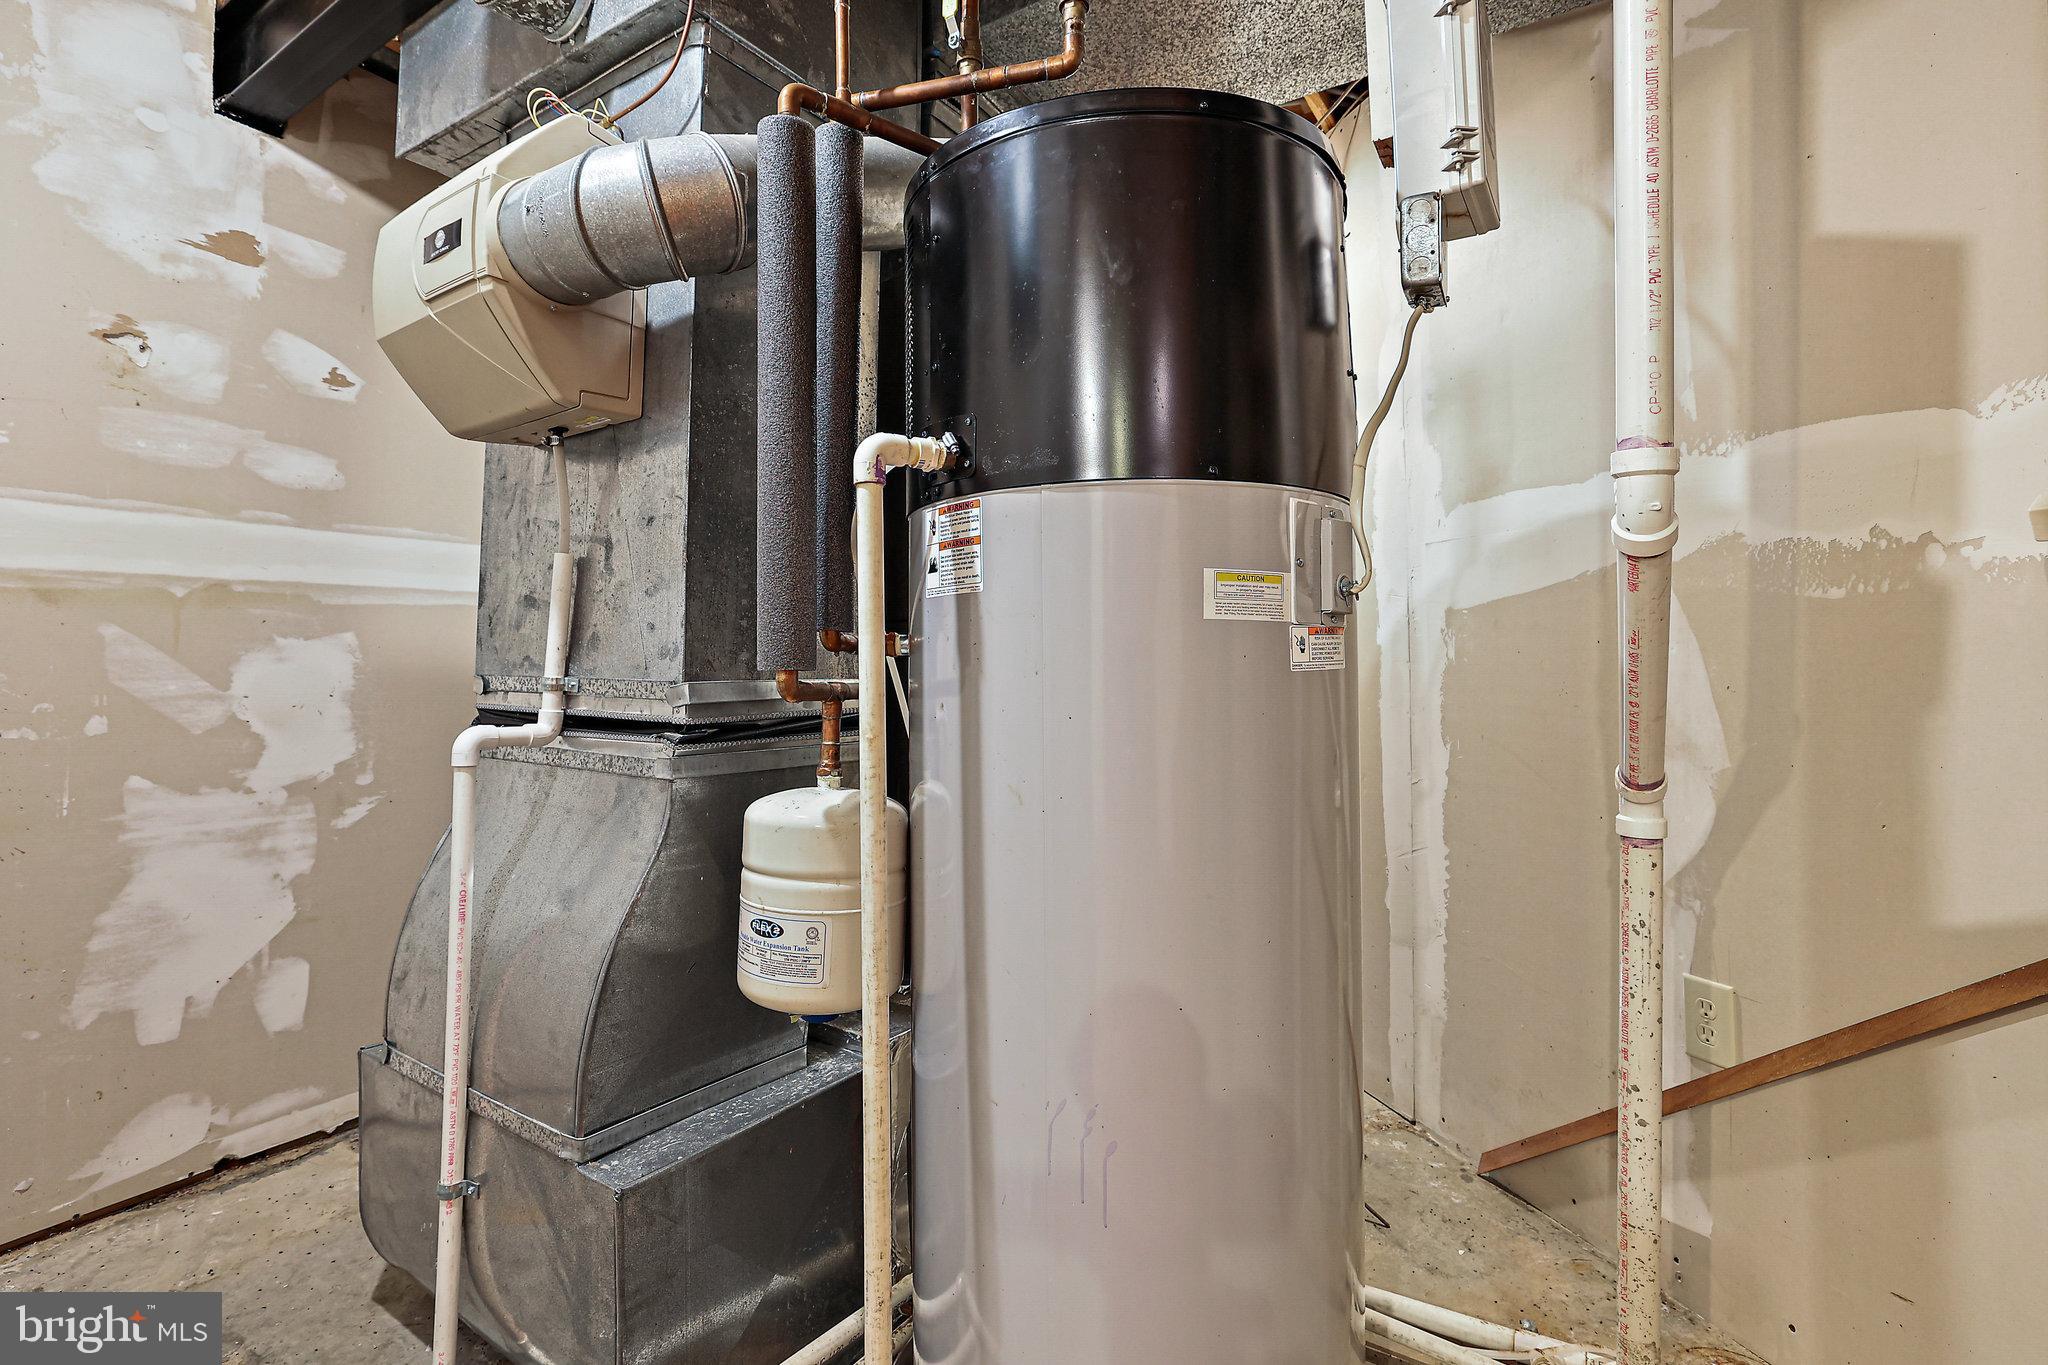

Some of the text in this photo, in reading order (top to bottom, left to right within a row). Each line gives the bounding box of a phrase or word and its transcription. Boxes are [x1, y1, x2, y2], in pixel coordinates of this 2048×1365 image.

[1646, 67, 1658, 111] CHARLOTTE
[1646, 115, 1659, 142] D-2665
[1646, 147, 1659, 167] ASTM
[1647, 173, 1659, 183] 40
[1649, 268, 1661, 284] PVC
[1649, 355, 1660, 363] P
[947, 538, 975, 548] WARNING
[750, 938, 762, 946] Water
[763, 941, 791, 951] Expansion
[794, 944, 809, 952] Tank
[1621, 1010, 1629, 1044] CHARLOTTE
[453, 1032, 460, 1041] AT
